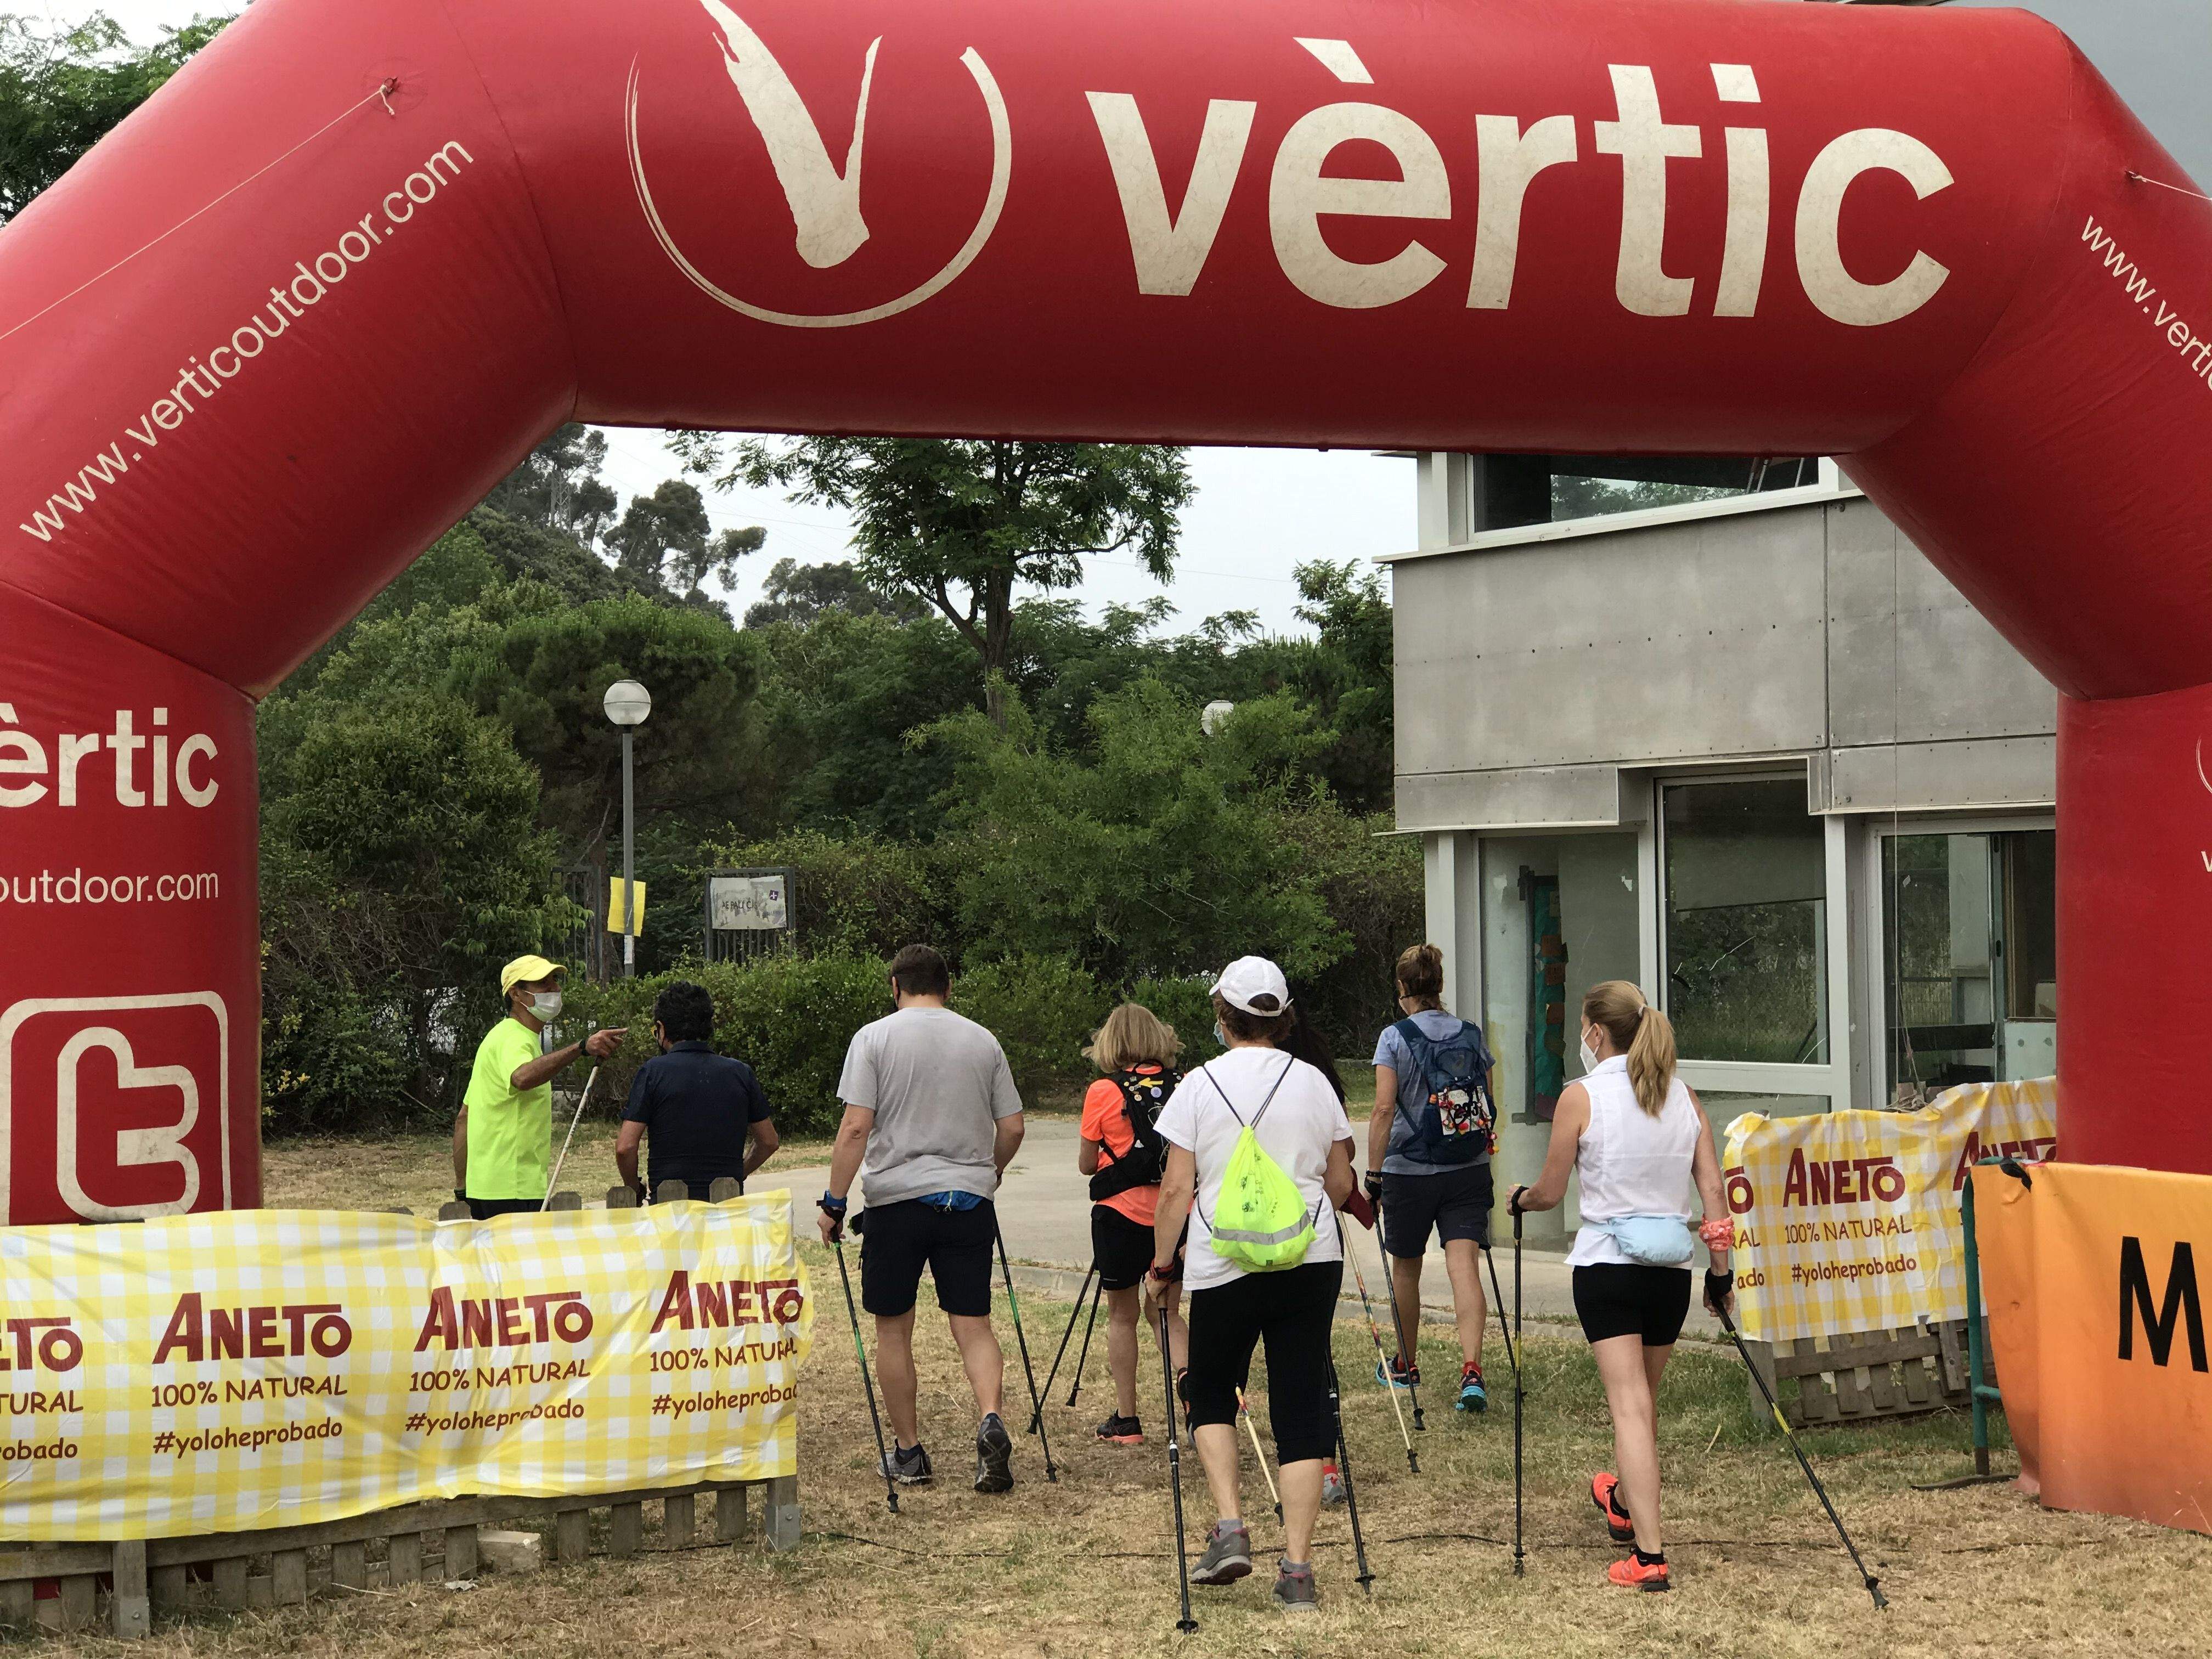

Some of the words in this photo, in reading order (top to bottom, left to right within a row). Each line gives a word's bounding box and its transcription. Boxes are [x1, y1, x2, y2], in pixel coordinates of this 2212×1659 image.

[1085, 36, 1954, 326] vèrtic
[2081, 216, 2212, 390] www.verti
[20, 140, 473, 542] www.verticoutdoor.com
[1783, 1148, 1905, 1207] ANETO
[1785, 1223, 1820, 1244] 100%
[1824, 1216, 1912, 1241] NATURAL
[1792, 1254, 1916, 1287] #yoloheprobado
[153, 1293, 352, 1364] ANETO
[414, 1286, 593, 1352] ANETO
[650, 1271, 804, 1334] ANETO
[2118, 1236, 2209, 1373] M
[0, 1317, 83, 1372] TO
[650, 1348, 708, 1372] 100%
[152, 1385, 218, 1407] 100%
[226, 1375, 347, 1403] NATURAL
[409, 1369, 470, 1391] 100%
[477, 1359, 590, 1389] NATURAL
[0, 1437, 77, 1460] obado
[153, 1417, 342, 1459] #yoloheprobado
